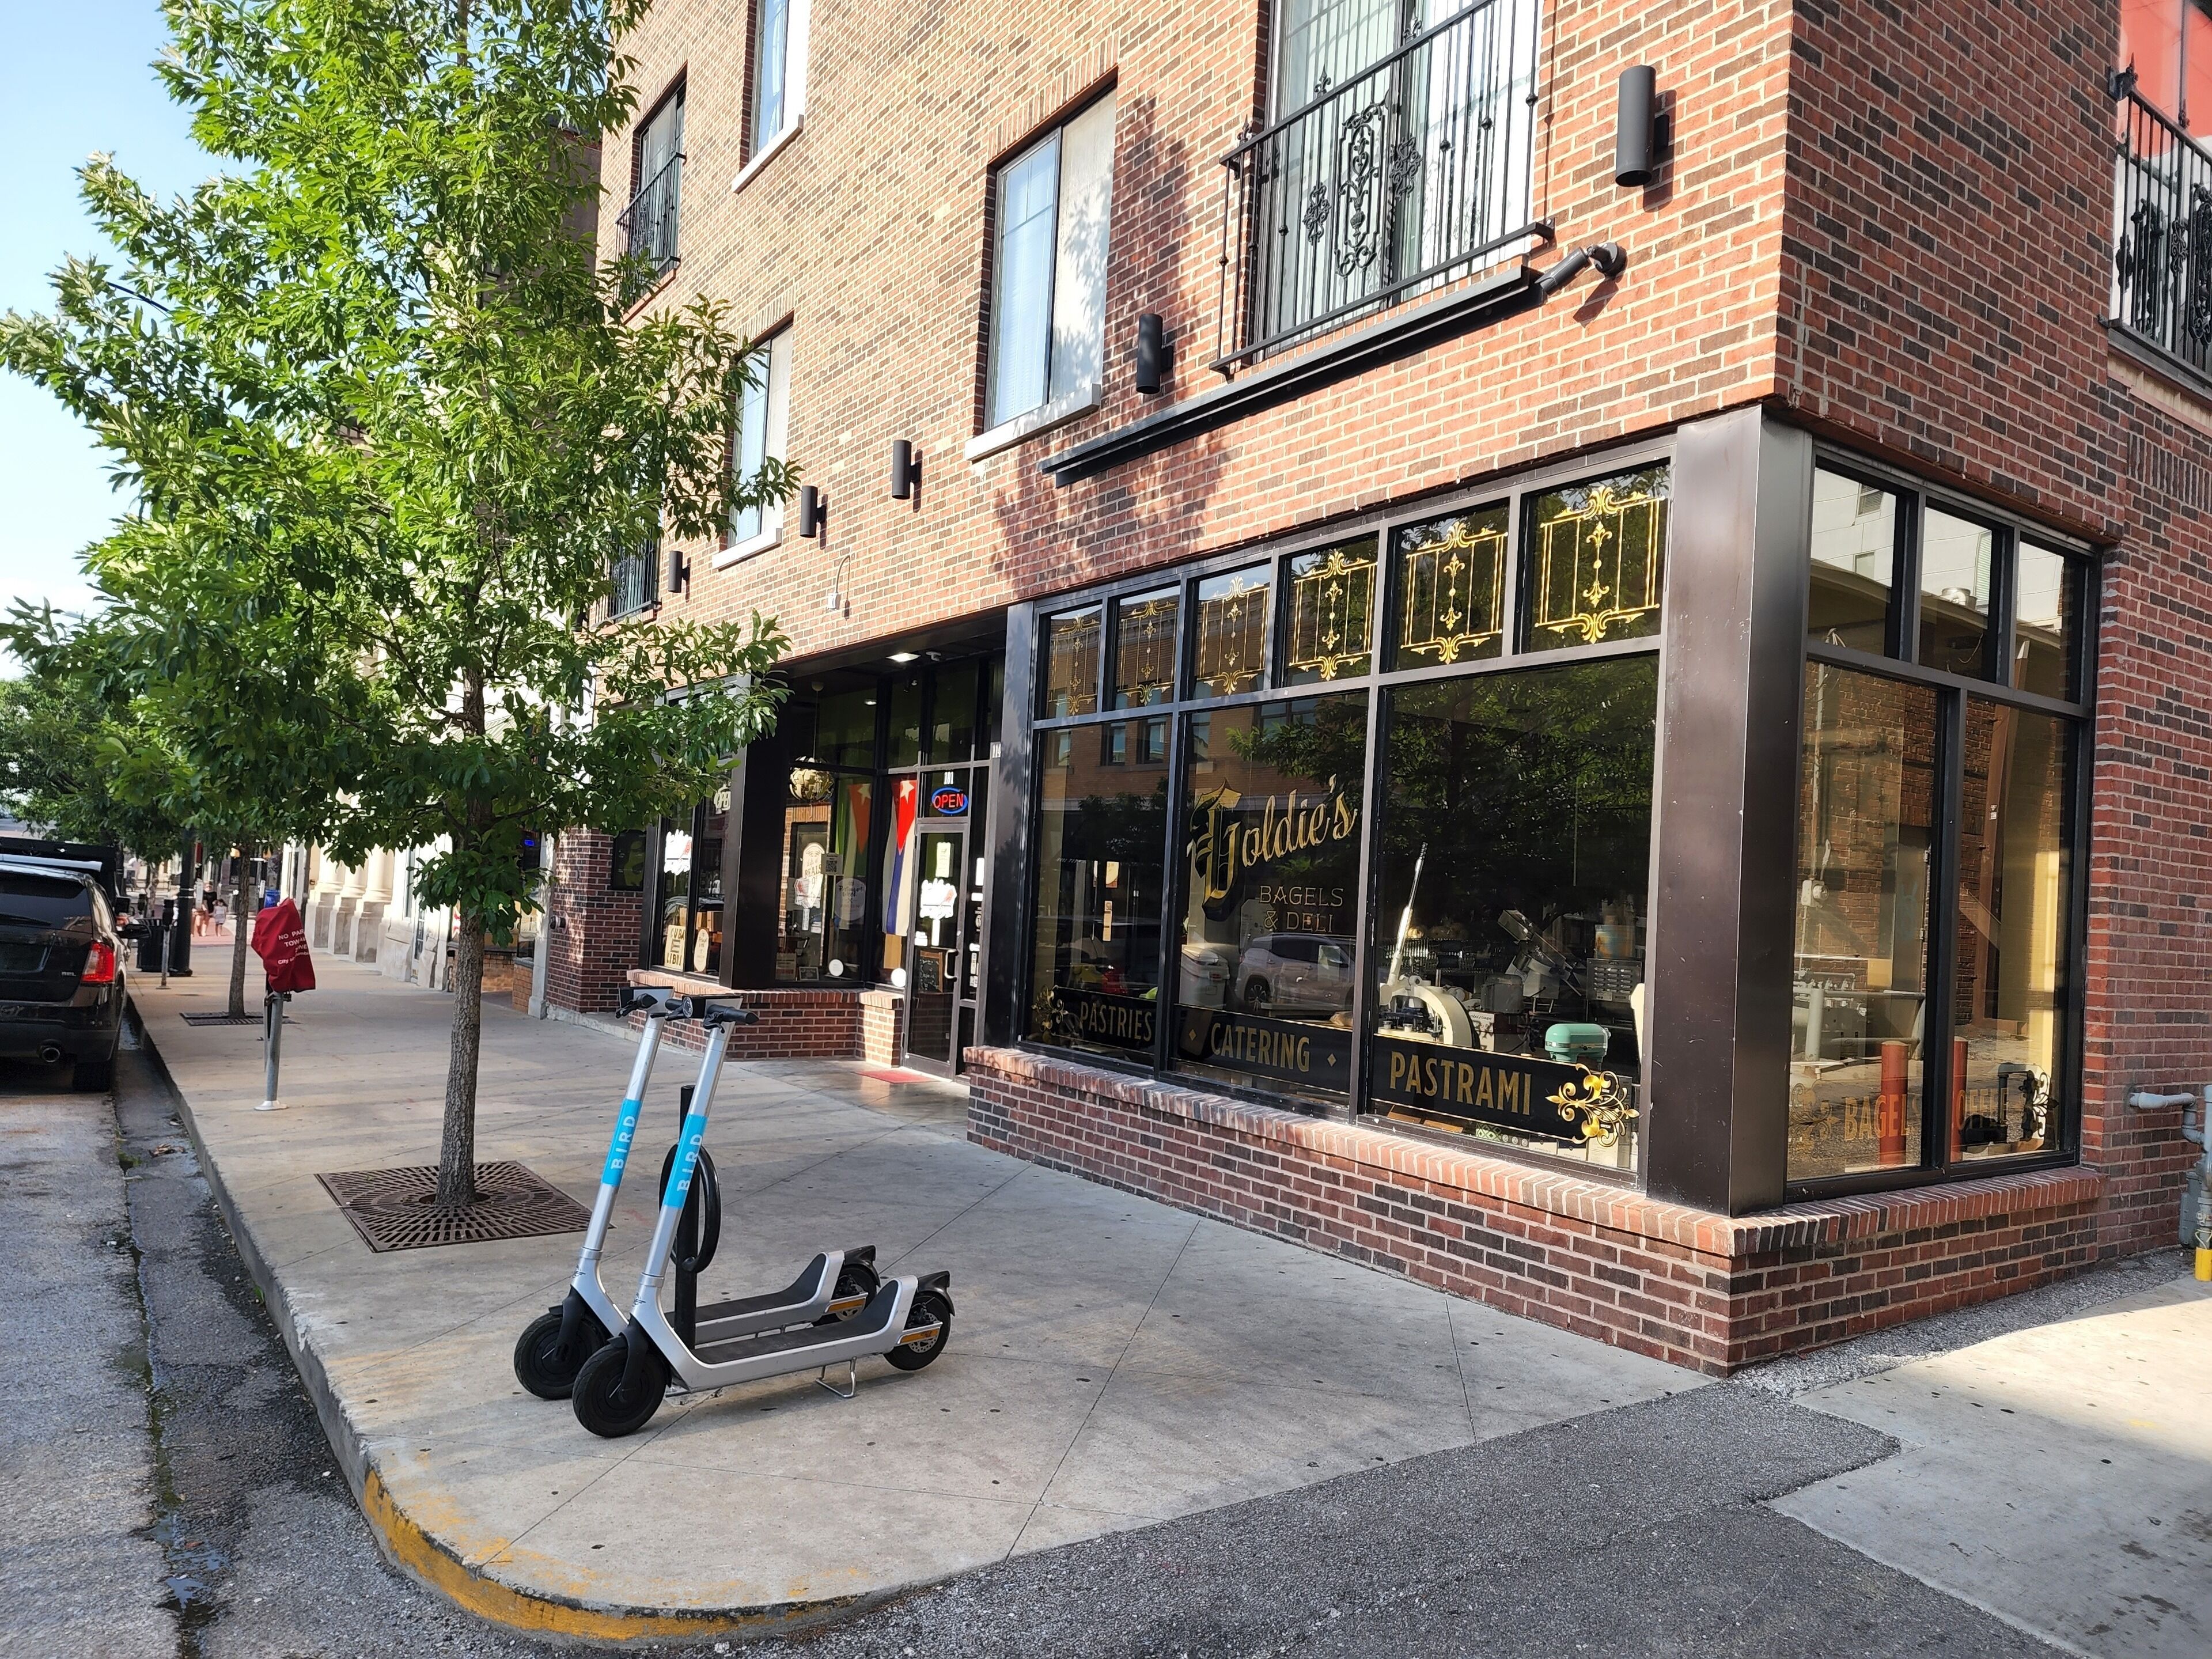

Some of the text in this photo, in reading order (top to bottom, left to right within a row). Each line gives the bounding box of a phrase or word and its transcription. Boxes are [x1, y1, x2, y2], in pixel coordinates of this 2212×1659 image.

[933, 793, 964, 809] OPEN
[944, 771, 954, 785] 101
[1187, 774, 1358, 903] Goldie's
[1259, 885, 1344, 907] BAGELS
[1263, 910, 1334, 933] & DELI
[1079, 1001, 1152, 1042] PASTRIES
[1210, 1022, 1310, 1073] CATERING
[1389, 1050, 1532, 1116] PASTRAMI
[611, 1115, 636, 1169] BIRD
[677, 1134, 703, 1191] BIRD
